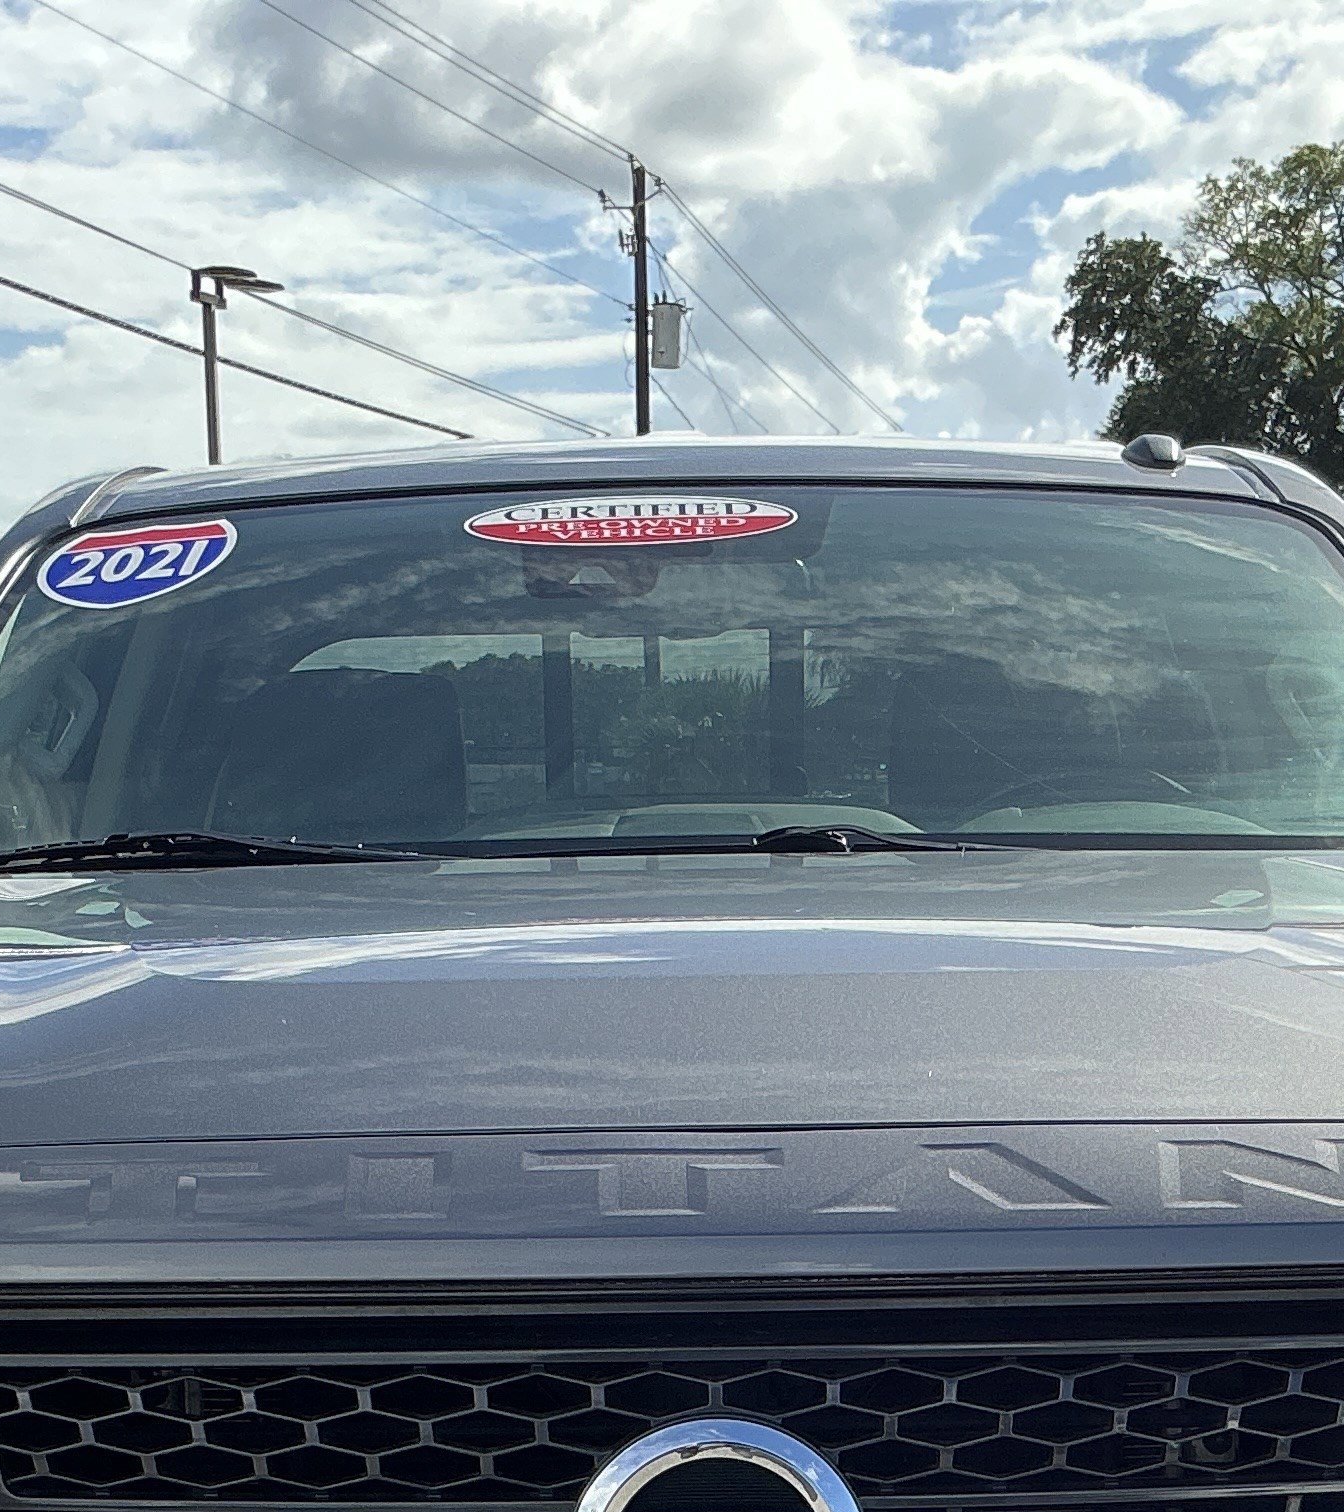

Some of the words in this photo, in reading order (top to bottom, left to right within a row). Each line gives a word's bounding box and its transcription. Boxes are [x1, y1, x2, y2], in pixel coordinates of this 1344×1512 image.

[503, 502, 759, 523] CERTIFIED
[515, 517, 748, 534] PRE-OWNED
[551, 526, 716, 540] VEHICLE
[56, 540, 210, 588] 2021
